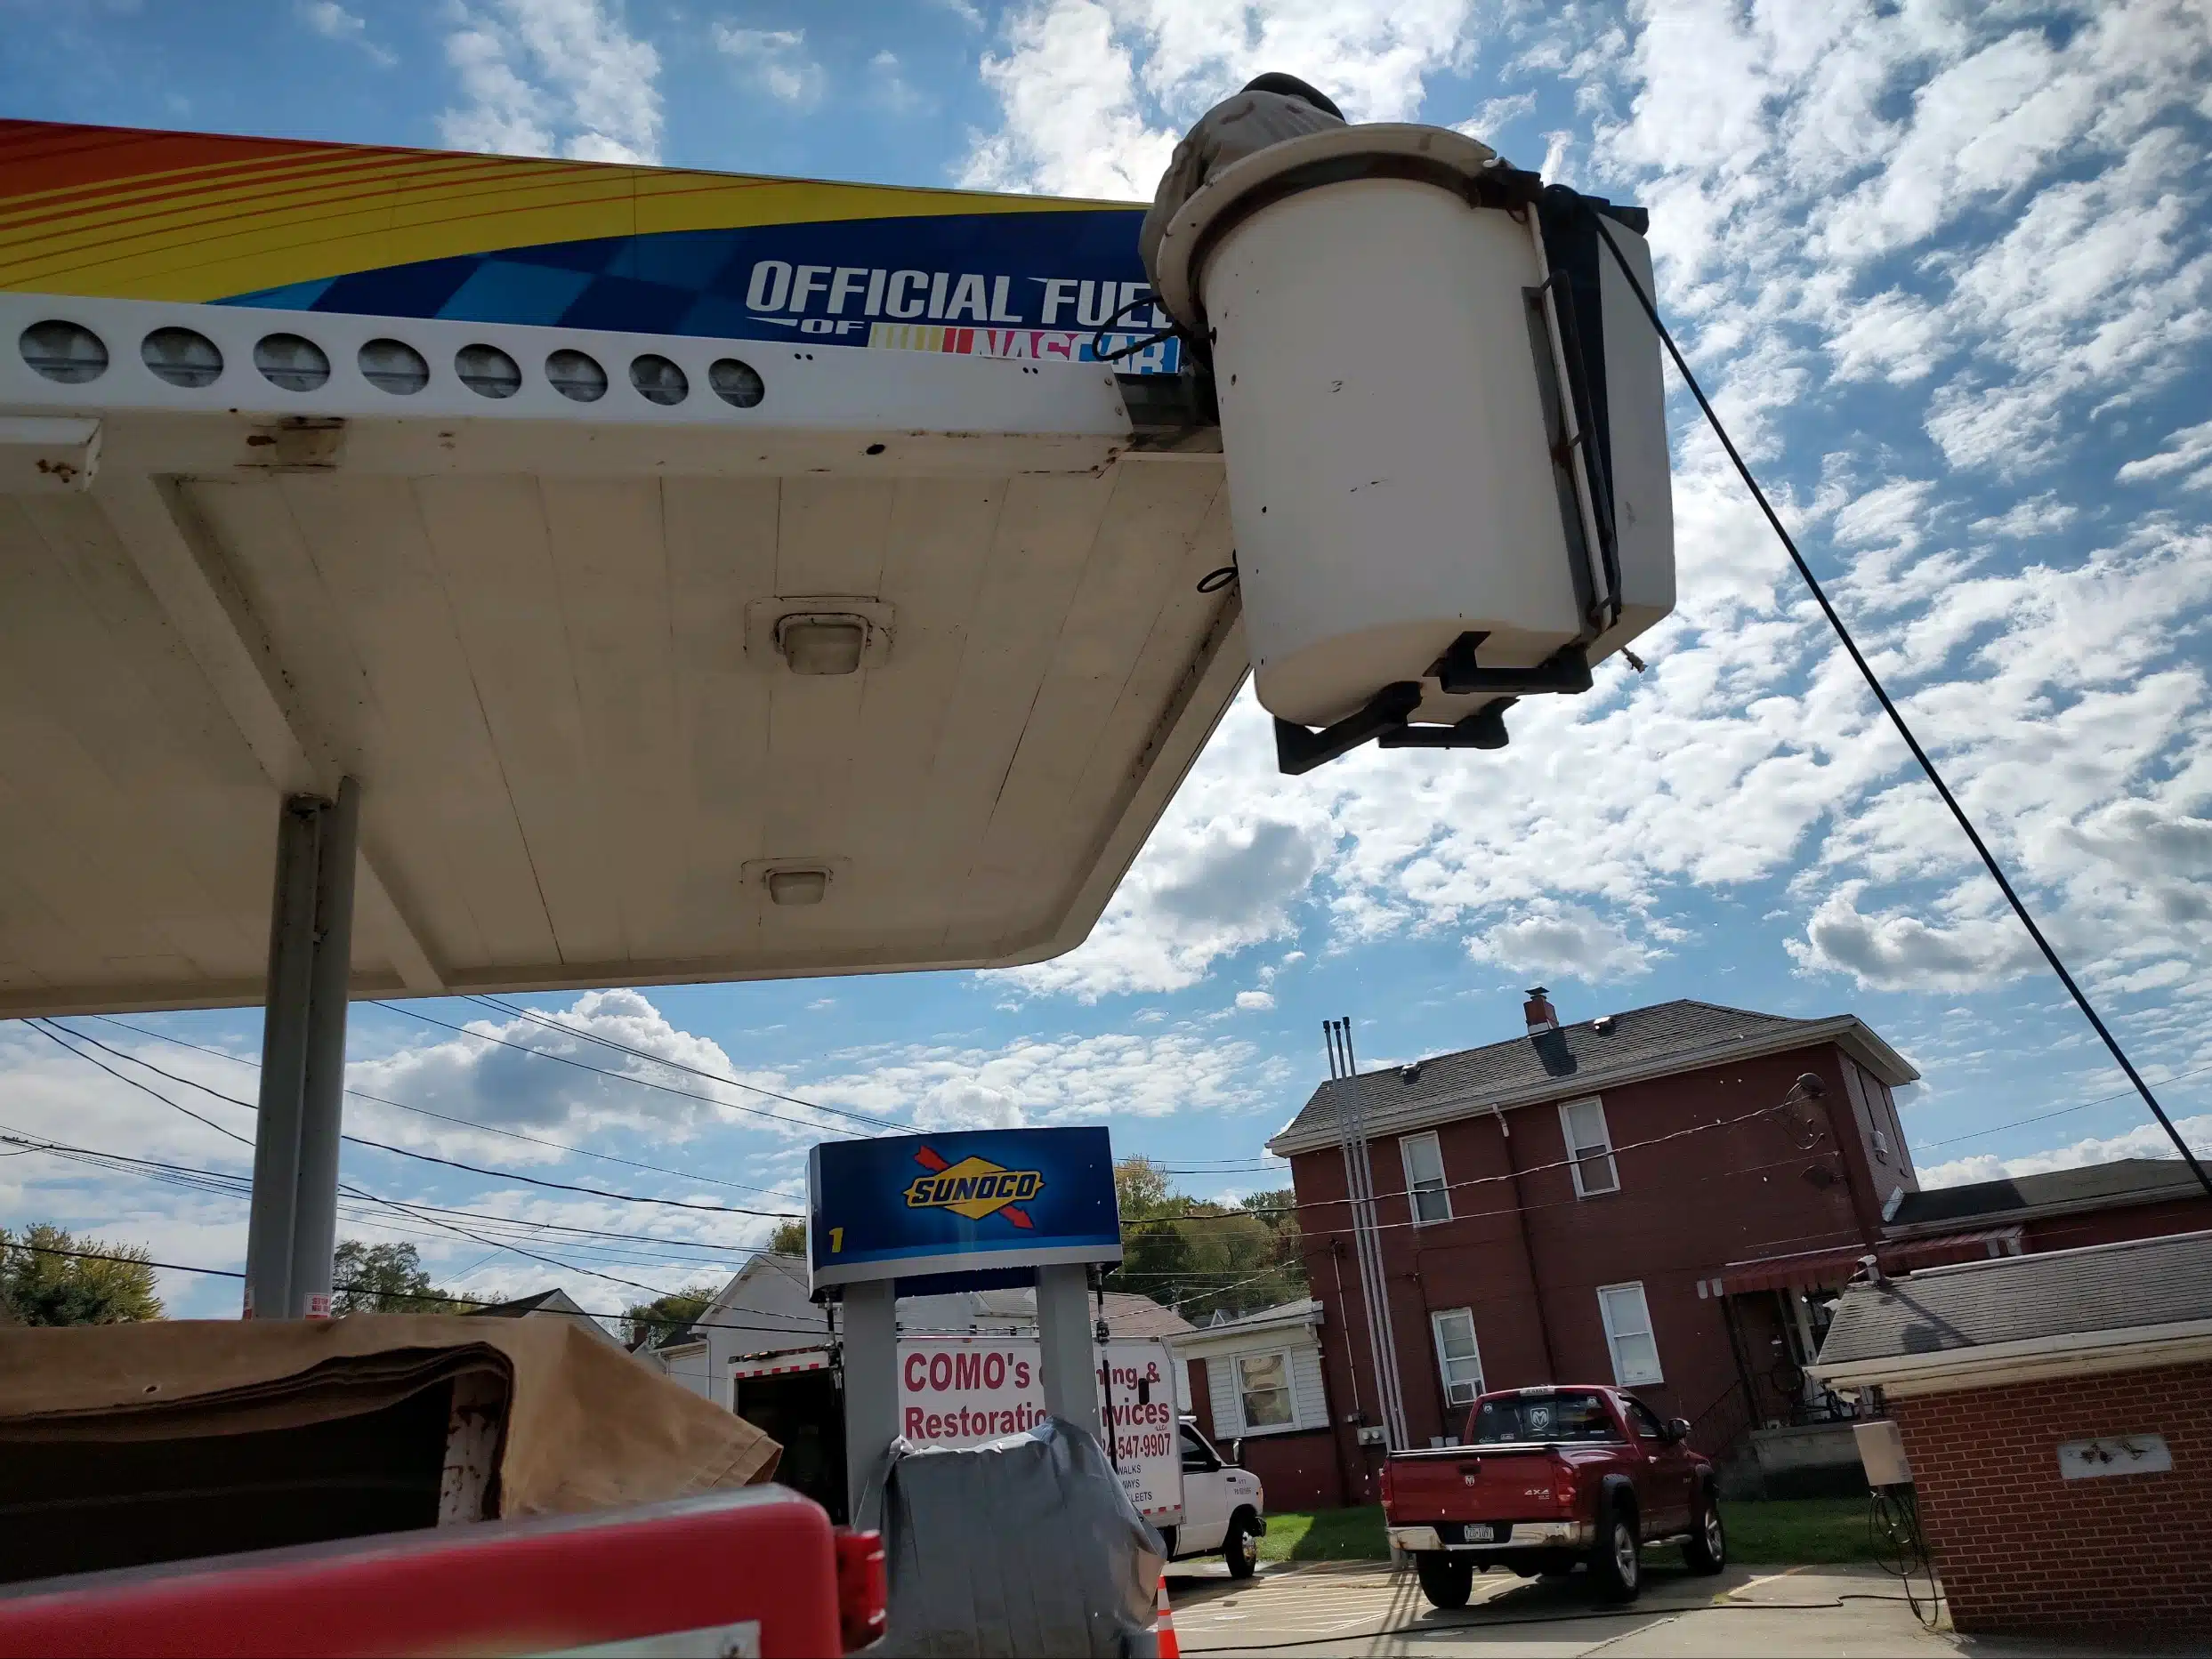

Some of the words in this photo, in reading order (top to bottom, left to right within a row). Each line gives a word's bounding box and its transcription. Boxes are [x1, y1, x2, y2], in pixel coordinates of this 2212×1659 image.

[746, 261, 1022, 323] OFFICIAL
[800, 319, 865, 334] OF
[911, 1172, 1037, 1204] SUNOCO
[828, 1227, 844, 1253] 1
[904, 1352, 1030, 1392] COMO's
[1146, 1361, 1160, 1384] &
[905, 1402, 1047, 1439] Restoratio
